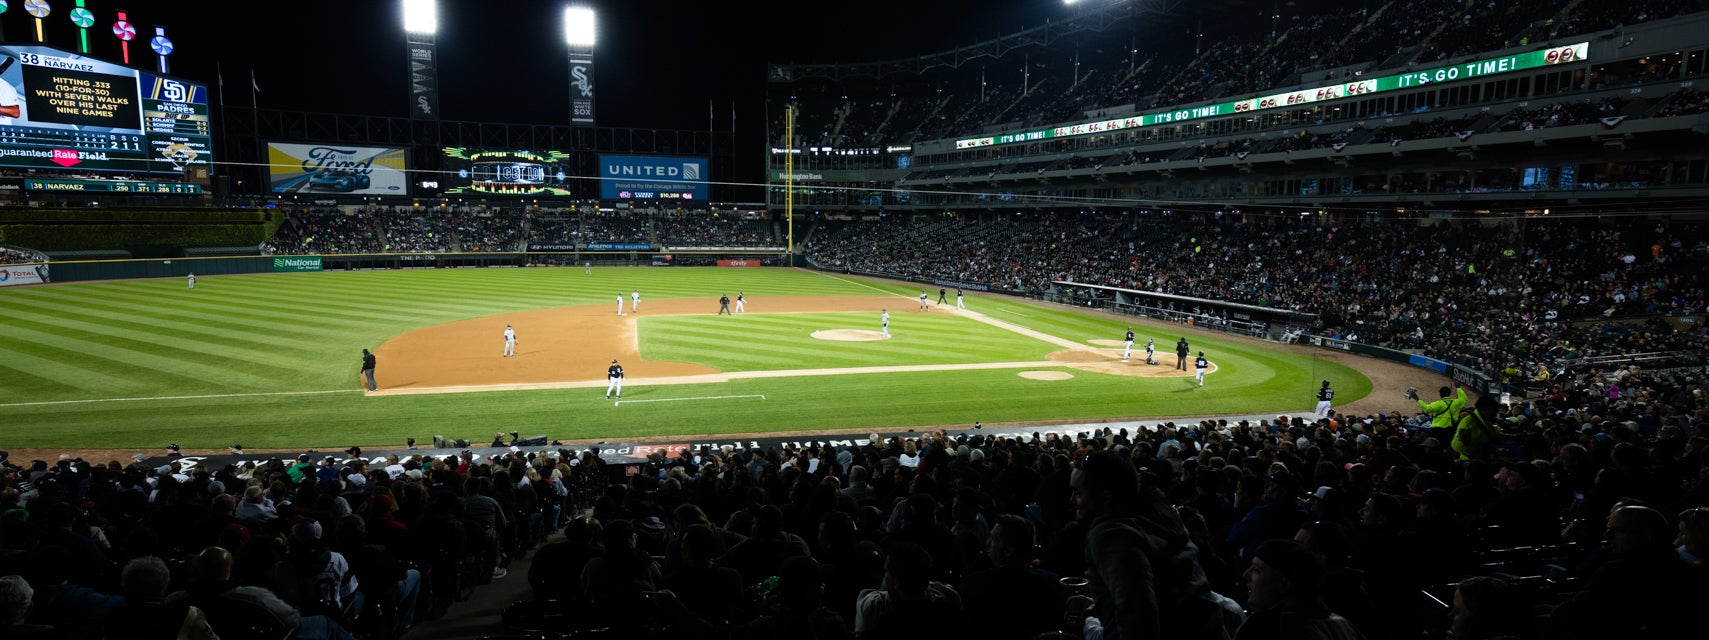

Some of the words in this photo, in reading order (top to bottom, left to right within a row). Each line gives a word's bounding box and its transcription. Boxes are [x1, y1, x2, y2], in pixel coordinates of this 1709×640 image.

[21, 53, 39, 64] 38
[44, 60, 94, 71] NARVAEZ
[1399, 72, 1428, 88] IT'S
[1435, 68, 1459, 82] GO
[1466, 58, 1516, 76] TIME!
[52, 76, 90, 86] HITTING
[56, 85, 110, 96] (10-FOR-30)
[36, 90, 62, 98] WITH
[64, 93, 94, 101] SEVEN
[97, 96, 129, 104] WALKS
[82, 109, 113, 117] GAMES
[157, 105, 195, 114] PADRES
[1154, 113, 1172, 123] IT'S
[1175, 110, 1188, 120] GO
[1192, 106, 1219, 118] TIME!
[1001, 135, 1013, 143] IT'S
[1027, 131, 1045, 140] TIME!
[0, 149, 53, 157] guaranteed
[54, 150, 78, 159] Rate
[79, 152, 109, 160] Field.
[302, 147, 374, 174] Ford
[609, 165, 678, 176] UNITED
